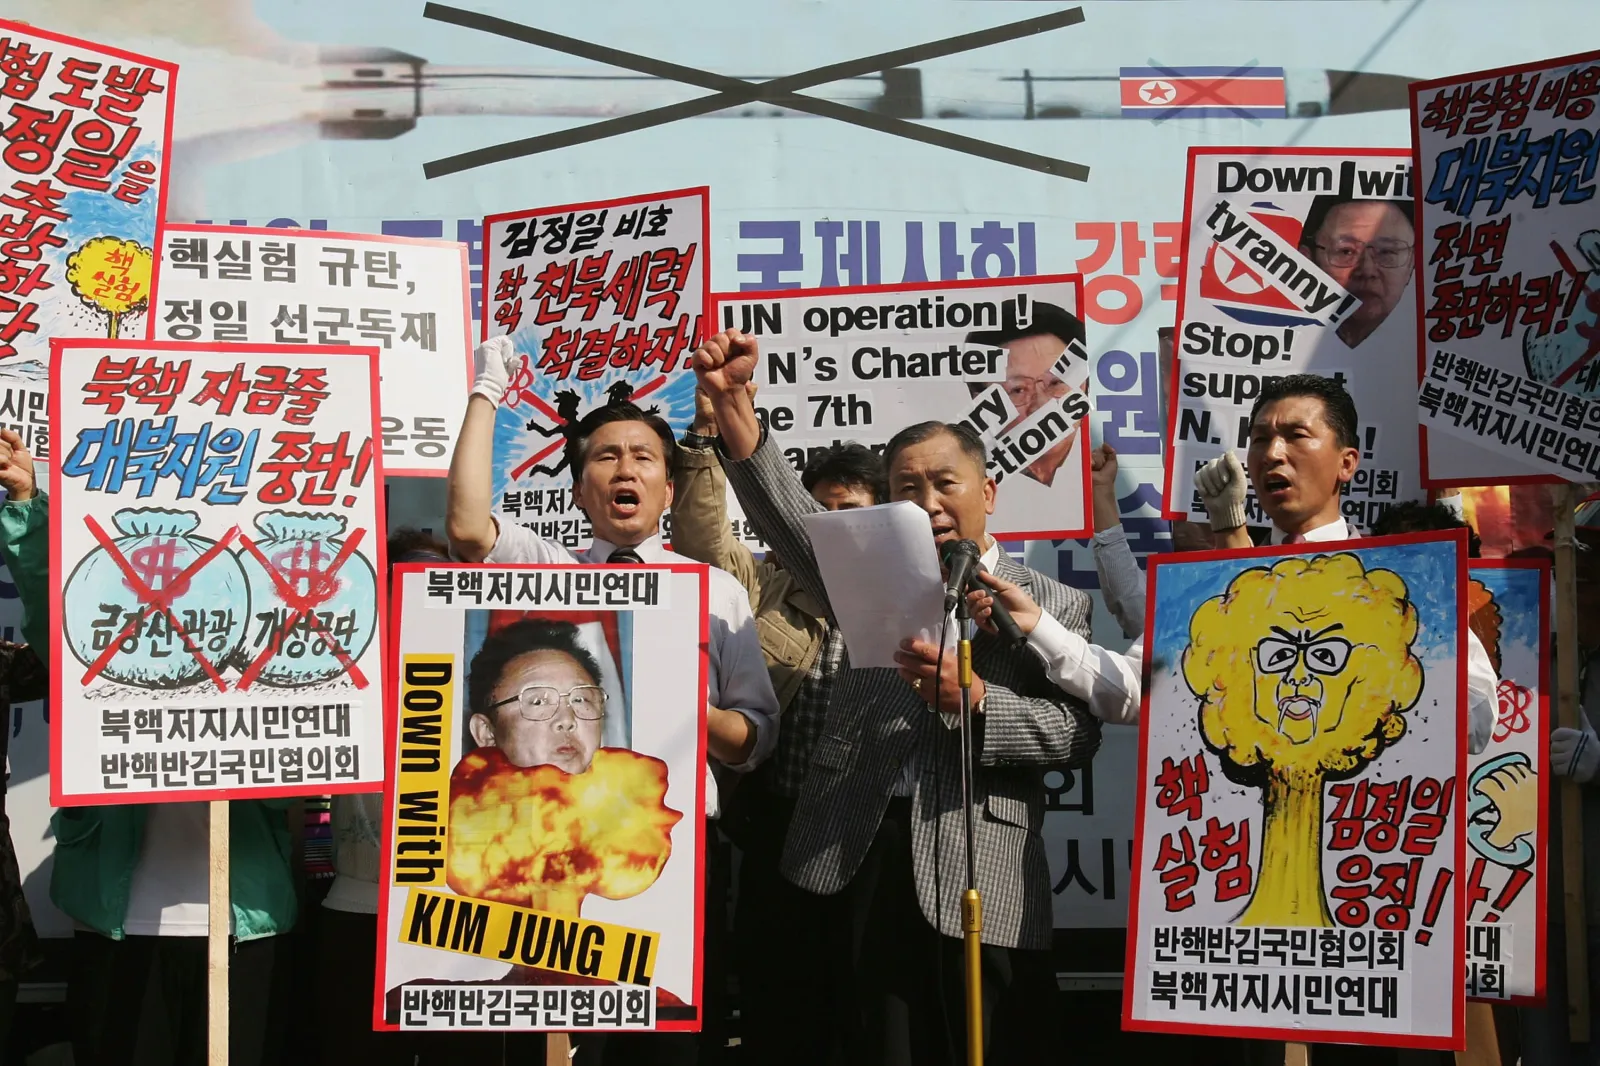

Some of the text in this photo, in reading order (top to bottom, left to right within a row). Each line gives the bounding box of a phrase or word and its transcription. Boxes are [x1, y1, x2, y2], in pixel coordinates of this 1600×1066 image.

[49, 57, 164, 124] 도발
[1421, 73, 1541, 139] 핵실험
[1217, 161, 1333, 194] Down
[1424, 127, 1600, 217] 대북지원
[500, 203, 673, 259] 김정일 비호
[1205, 199, 1357, 324] tyranny!
[1428, 214, 1511, 283] 전면
[168, 238, 296, 283] 핵실험
[319, 246, 416, 296] 규탄,
[530, 242, 698, 326] 친북세력
[163, 299, 437, 351] 정일 선군독재
[1424, 270, 1589, 343] 중단하라!
[851, 345, 1003, 379] Charter
[1182, 321, 1295, 365] Stop!
[81, 355, 331, 426] 북핵 자금줄
[807, 393, 872, 428] 7th
[61, 415, 374, 508] 대북지원 중단!
[427, 571, 659, 605] 북핵저지시민연대
[100, 703, 352, 744] 북핵저지시민연대
[100, 744, 360, 790] 반핵반김국민협의회
[395, 662, 453, 883] Down with
[1155, 753, 1210, 822] 핵
[1327, 775, 1455, 856] 김정일
[1153, 817, 1254, 913] 실험
[408, 893, 652, 987] KIM JUNG IL
[1153, 927, 1404, 971] 반핵반김국민협의회
[403, 989, 651, 1026] 반핵반김국민협의회
[1150, 971, 1398, 1018] 북핵저지시민연대
